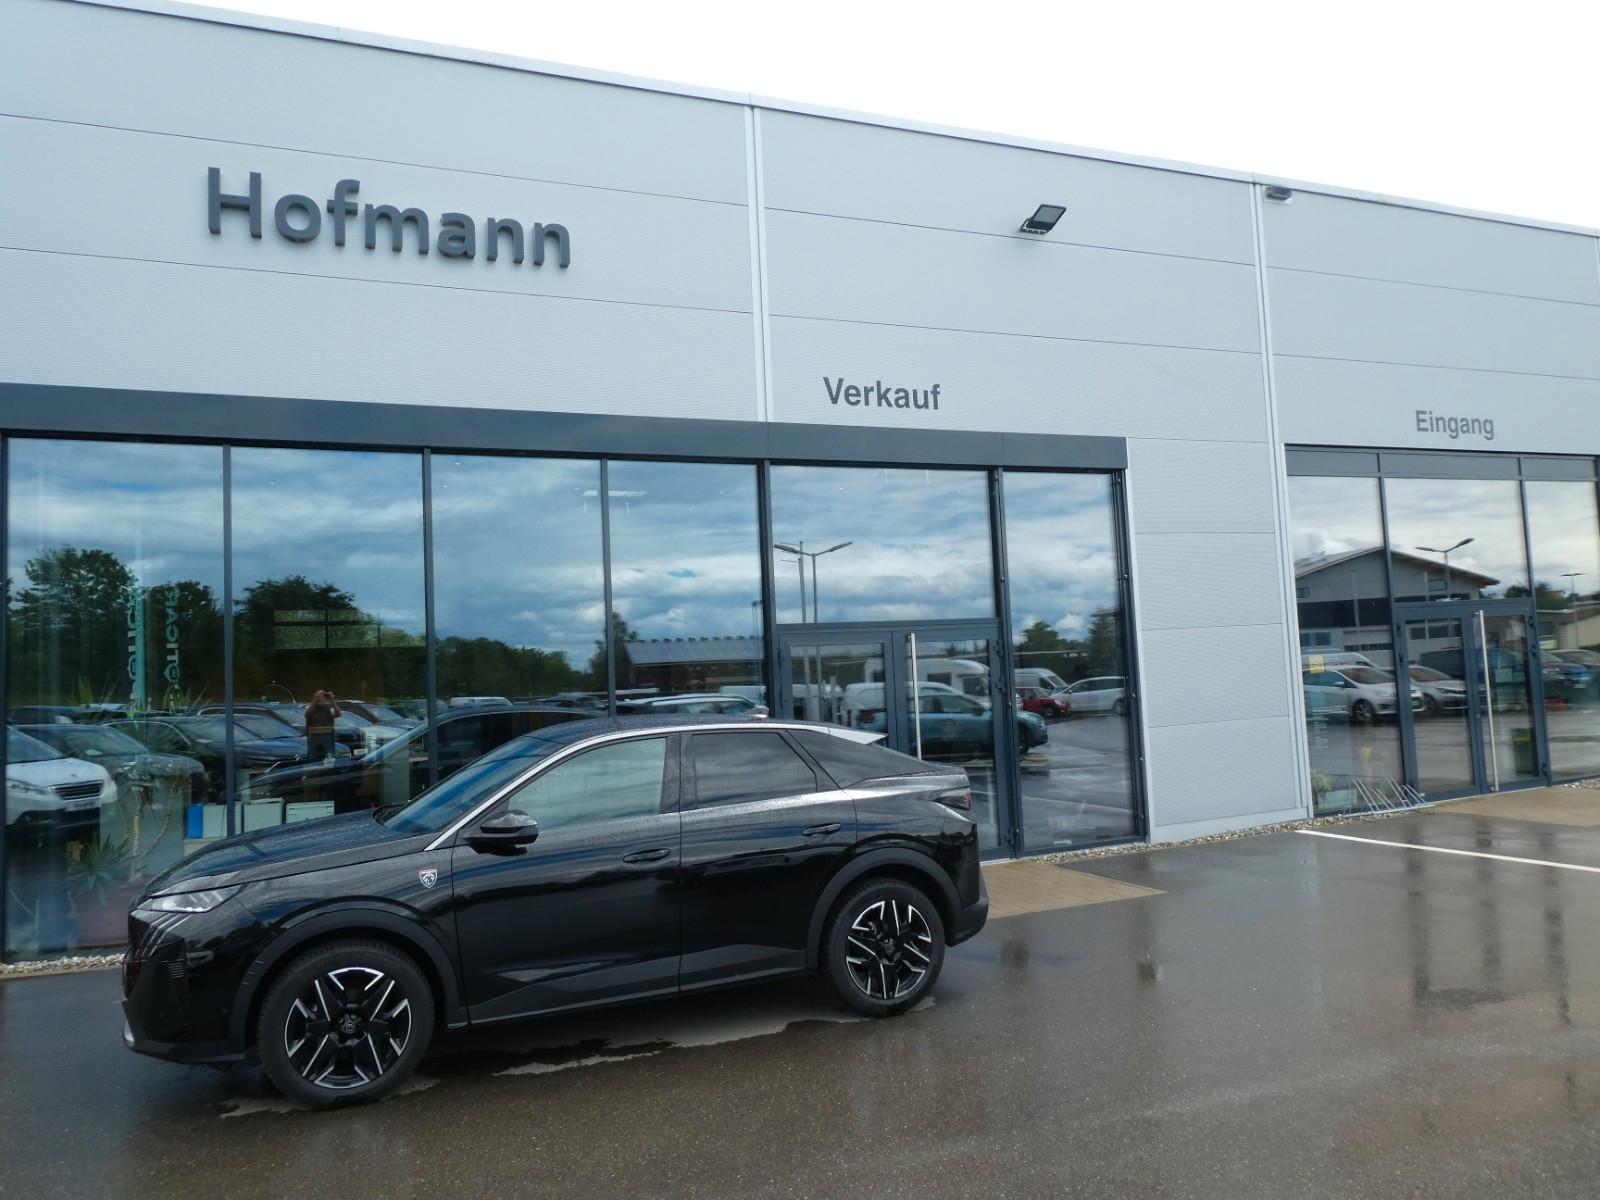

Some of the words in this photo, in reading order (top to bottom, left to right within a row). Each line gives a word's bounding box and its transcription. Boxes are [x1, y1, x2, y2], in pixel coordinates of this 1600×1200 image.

[207, 166, 571, 268] Hofmann
[822, 376, 941, 410] Verkauf
[1415, 409, 1494, 441] Eingang
